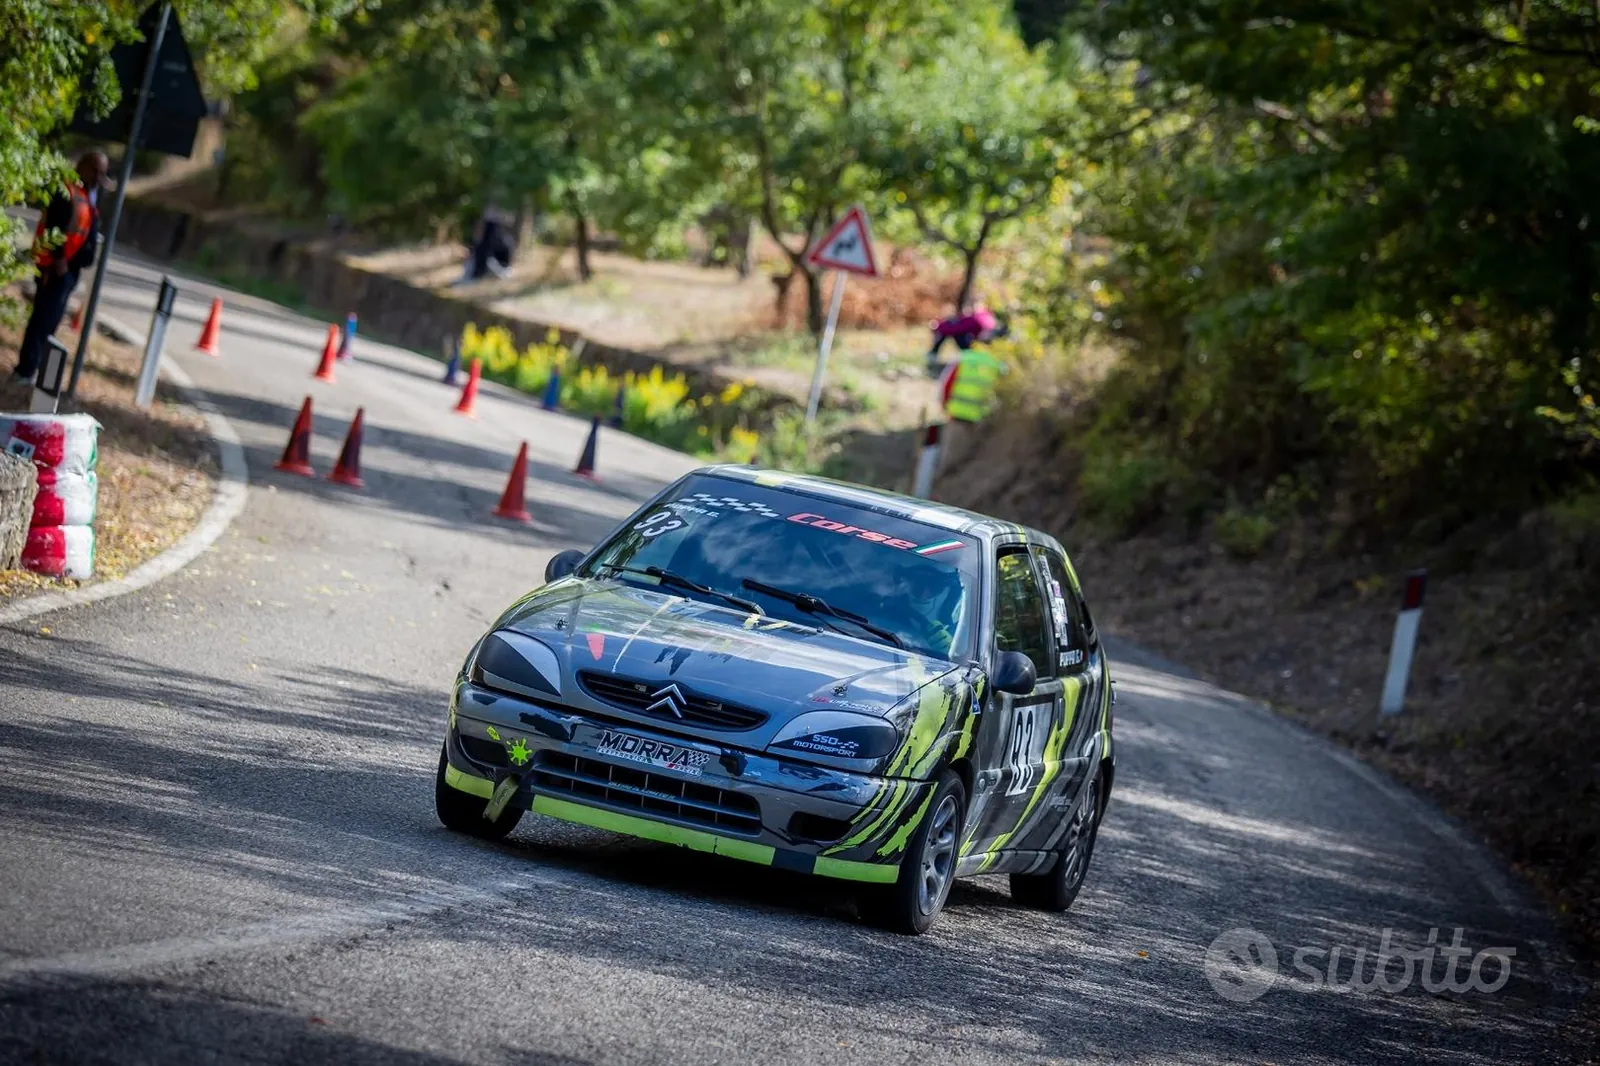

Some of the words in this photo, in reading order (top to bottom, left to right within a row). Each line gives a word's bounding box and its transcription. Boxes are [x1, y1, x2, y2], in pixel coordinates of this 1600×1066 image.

[633, 511, 682, 538] 93
[786, 513, 918, 550] Corse
[600, 730, 689, 766] MORRA
[793, 740, 858, 758] MOTORSPORT
[1009, 710, 1033, 794] 93
